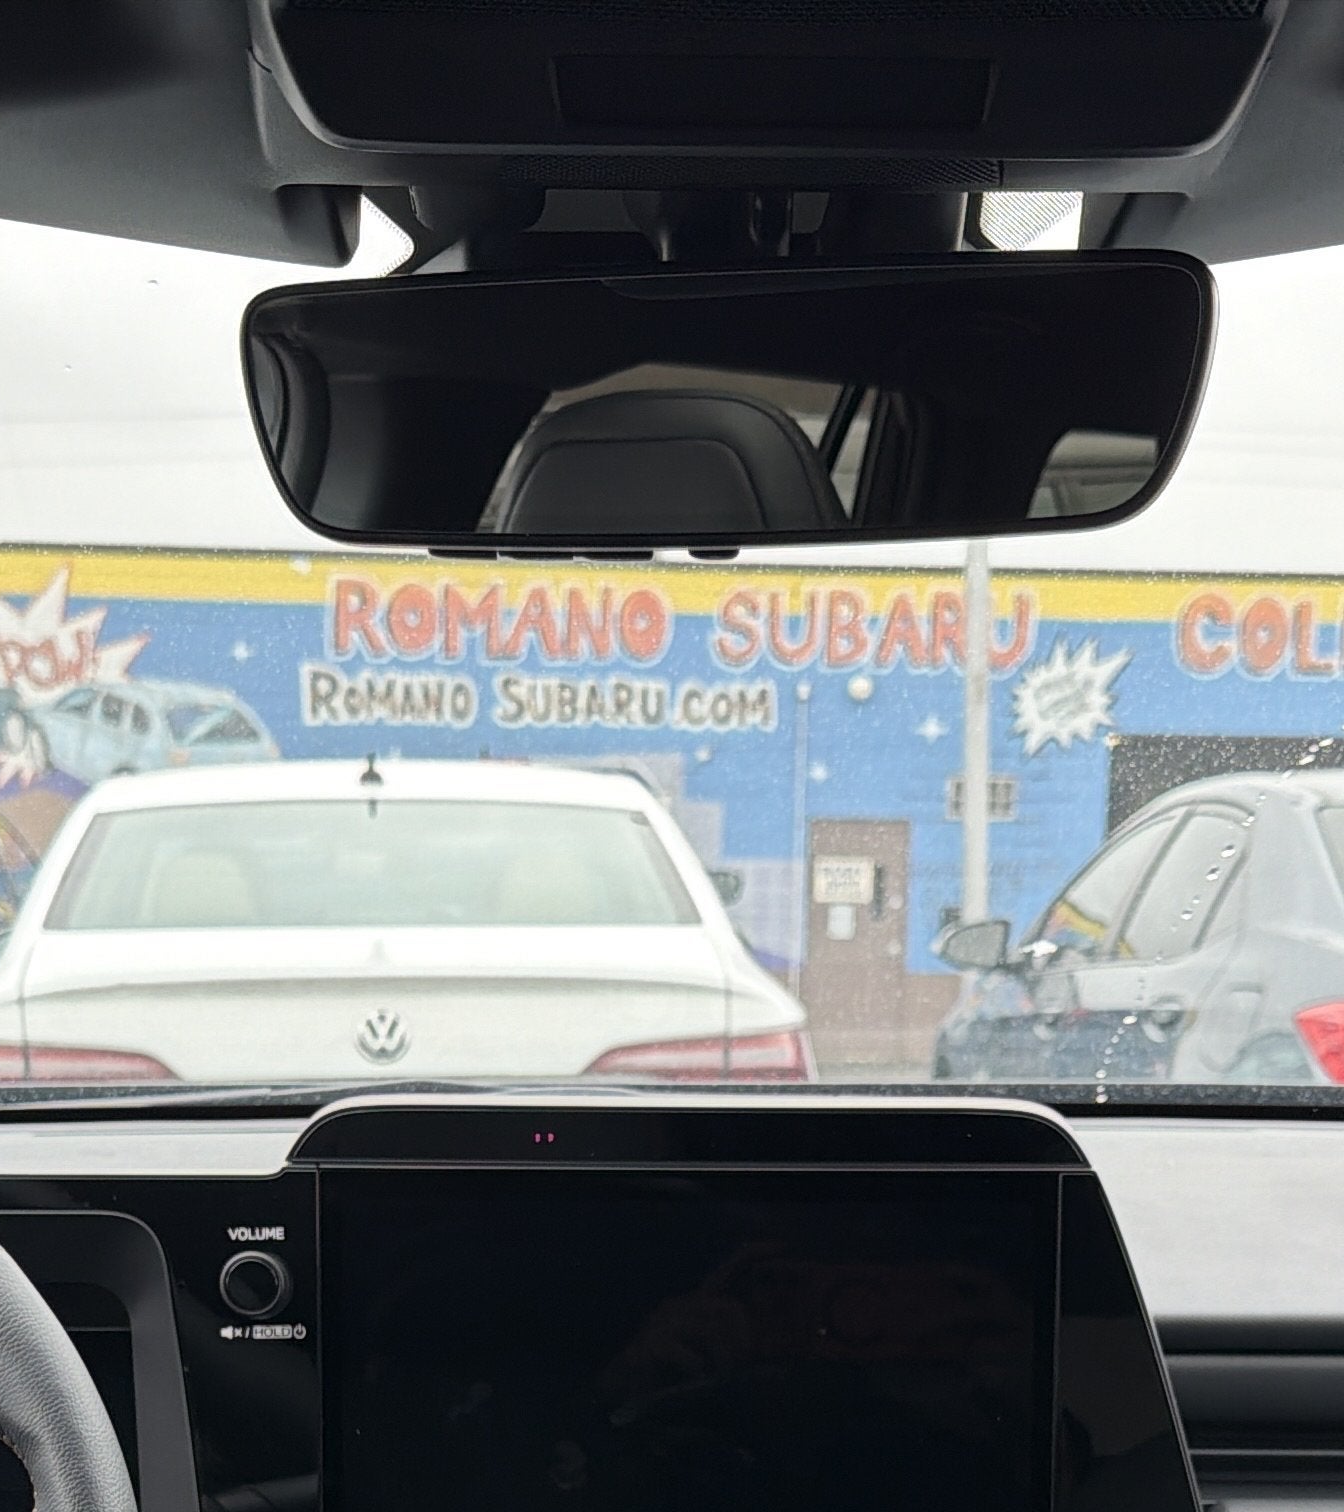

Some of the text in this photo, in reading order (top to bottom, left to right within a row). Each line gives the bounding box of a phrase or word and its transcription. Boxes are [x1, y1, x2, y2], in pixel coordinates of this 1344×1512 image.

[328, 576, 1035, 668] ROMANO SUBARU
[227, 1226, 285, 1241] VOLUME
[254, 1326, 292, 1338] HOLD
